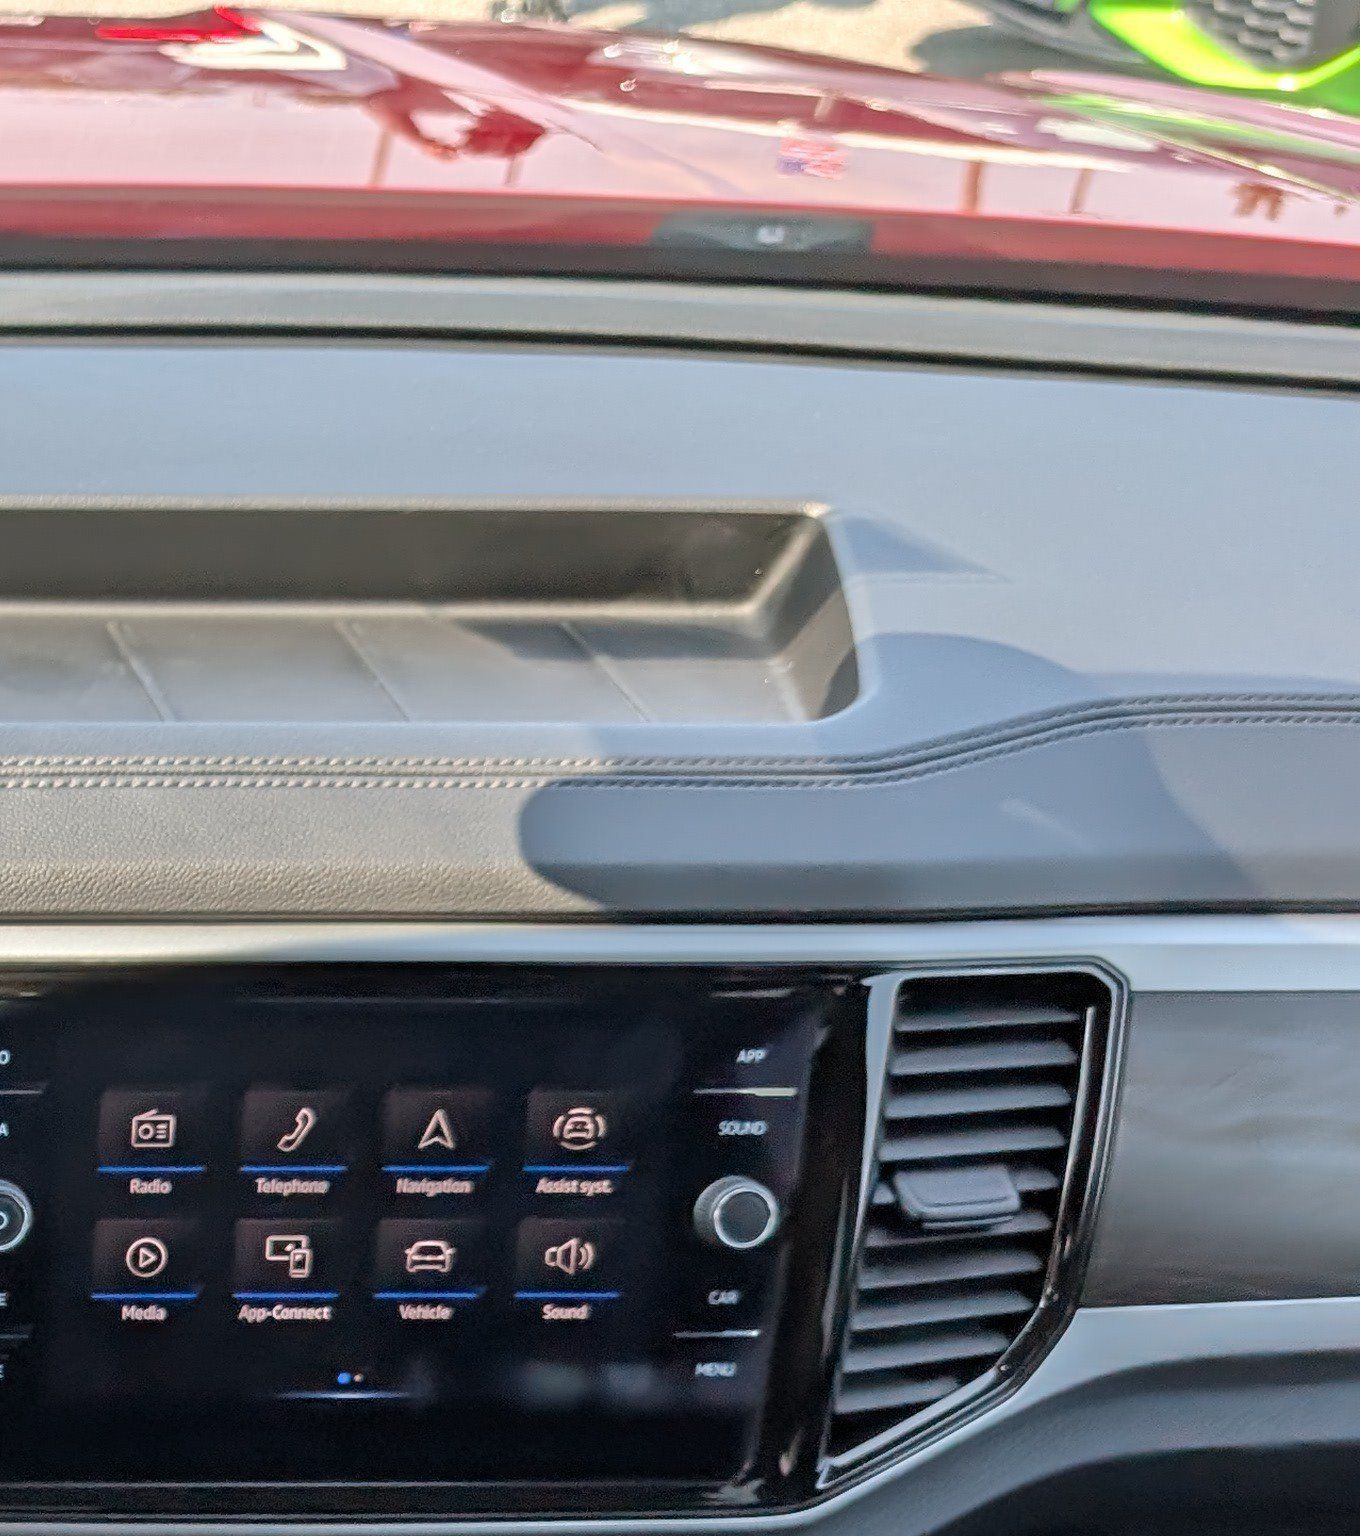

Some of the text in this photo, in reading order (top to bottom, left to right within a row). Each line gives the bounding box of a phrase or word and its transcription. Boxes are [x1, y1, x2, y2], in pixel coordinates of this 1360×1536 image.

[736, 1048, 768, 1064] APP
[718, 1120, 767, 1136] SOUND
[129, 1177, 172, 1195] Radio
[255, 1177, 330, 1197] Telephone
[395, 1177, 475, 1197] Navigation
[535, 1177, 579, 1195] Assist
[707, 1290, 740, 1306] CAR
[121, 1304, 168, 1321] Media
[237, 1304, 332, 1323] App-Connect
[398, 1302, 455, 1320] Vehicle
[542, 1302, 592, 1320] Sound
[694, 1362, 738, 1378] MENU
